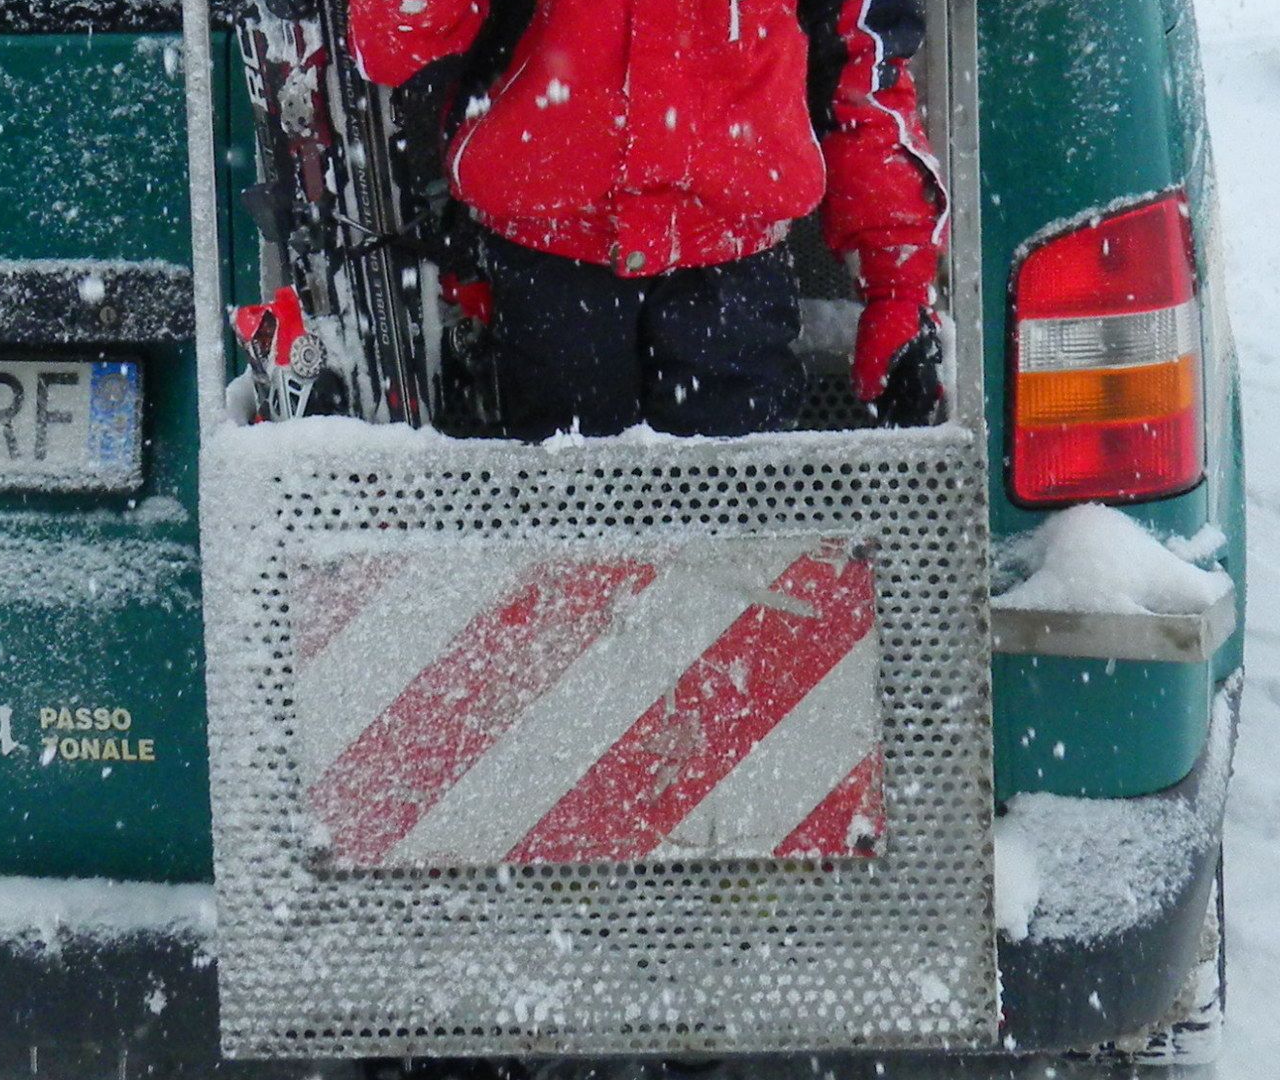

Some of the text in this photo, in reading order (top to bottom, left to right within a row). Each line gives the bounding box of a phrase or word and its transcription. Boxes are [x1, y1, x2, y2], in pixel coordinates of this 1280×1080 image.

[374, 280, 390, 346] DOUBLE
[40, 707, 132, 731] PASSO
[40, 736, 156, 762] TONALE
